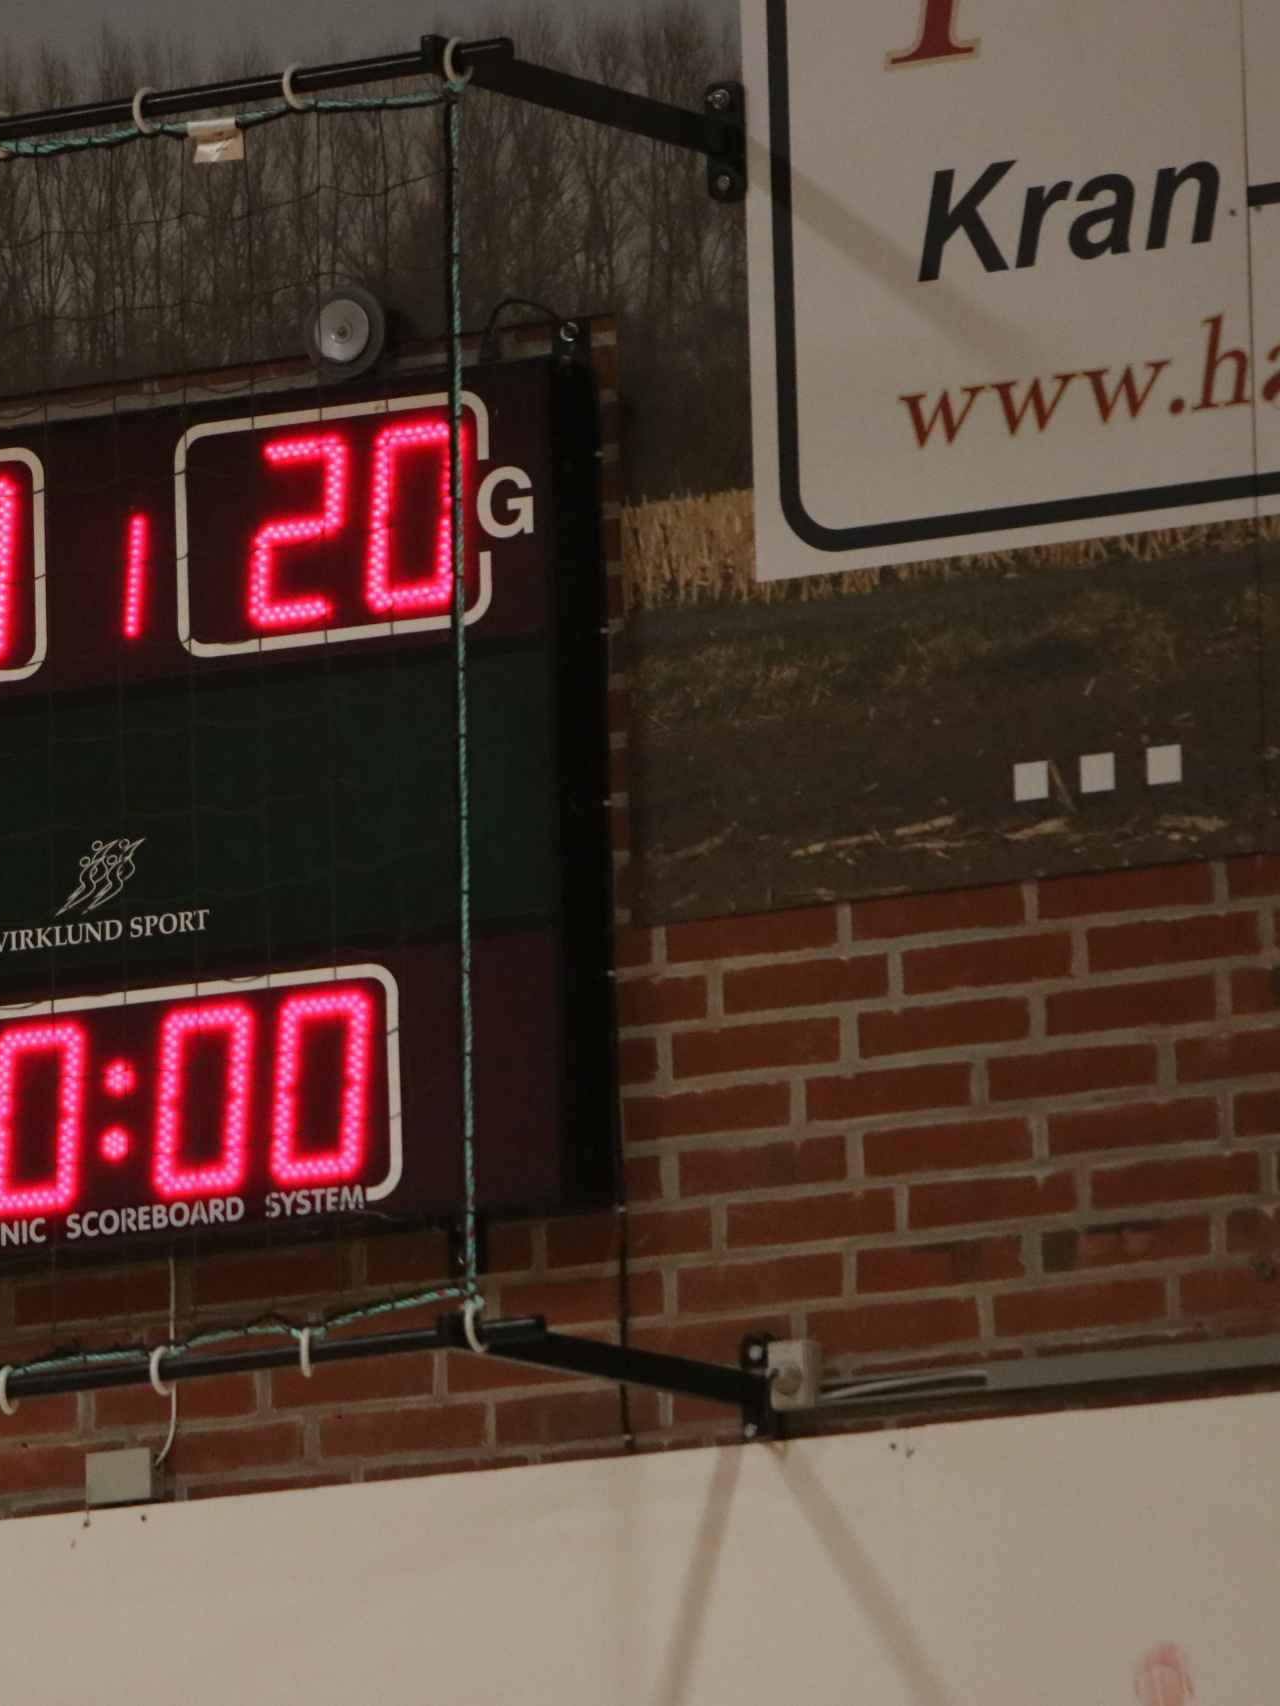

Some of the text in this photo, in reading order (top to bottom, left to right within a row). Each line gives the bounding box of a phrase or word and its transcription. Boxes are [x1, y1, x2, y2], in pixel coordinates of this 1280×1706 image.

[248, 418, 466, 628] 20
[477, 466, 533, 538] G
[129, 909, 210, 938] SPORT
[66, 1196, 245, 1240] SCOREBOARD
[265, 1185, 366, 1218] SYSTEM
